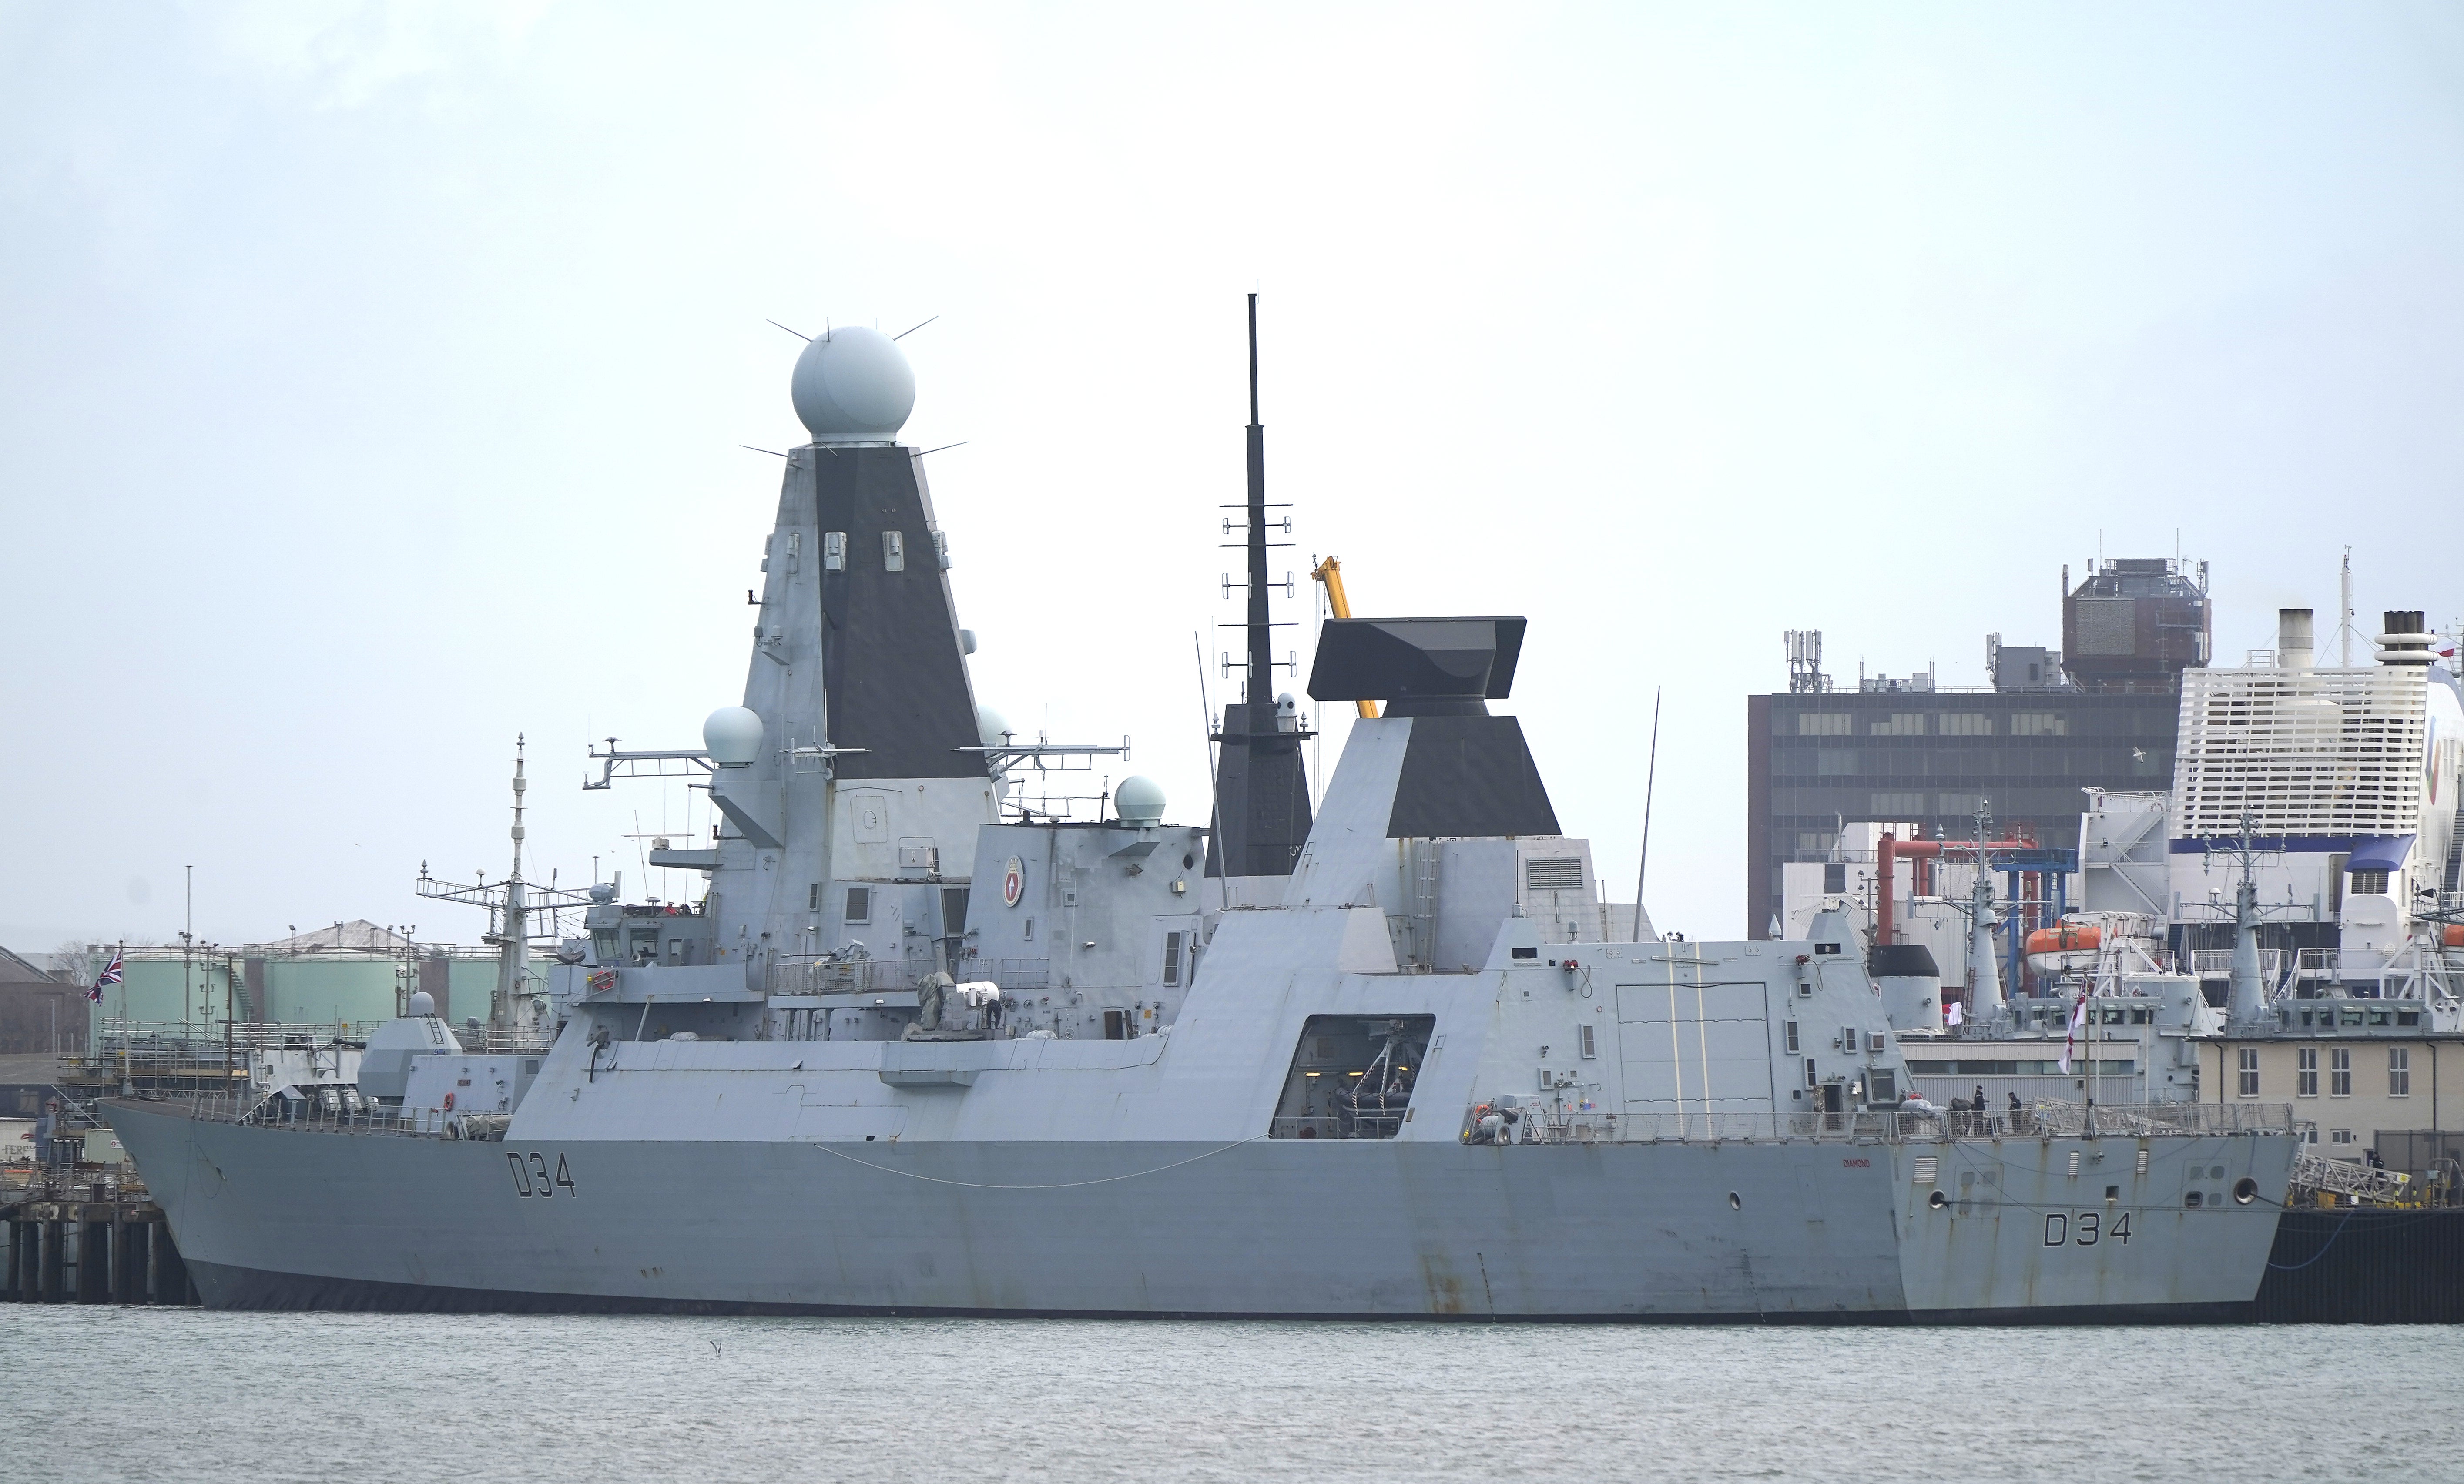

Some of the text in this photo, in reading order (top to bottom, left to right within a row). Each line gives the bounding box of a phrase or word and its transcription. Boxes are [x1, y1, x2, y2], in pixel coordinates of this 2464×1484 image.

[506, 1152, 577, 1198] D34
[1843, 1159, 1870, 1168] DIAMOND
[2043, 1211, 2132, 1247] D34
